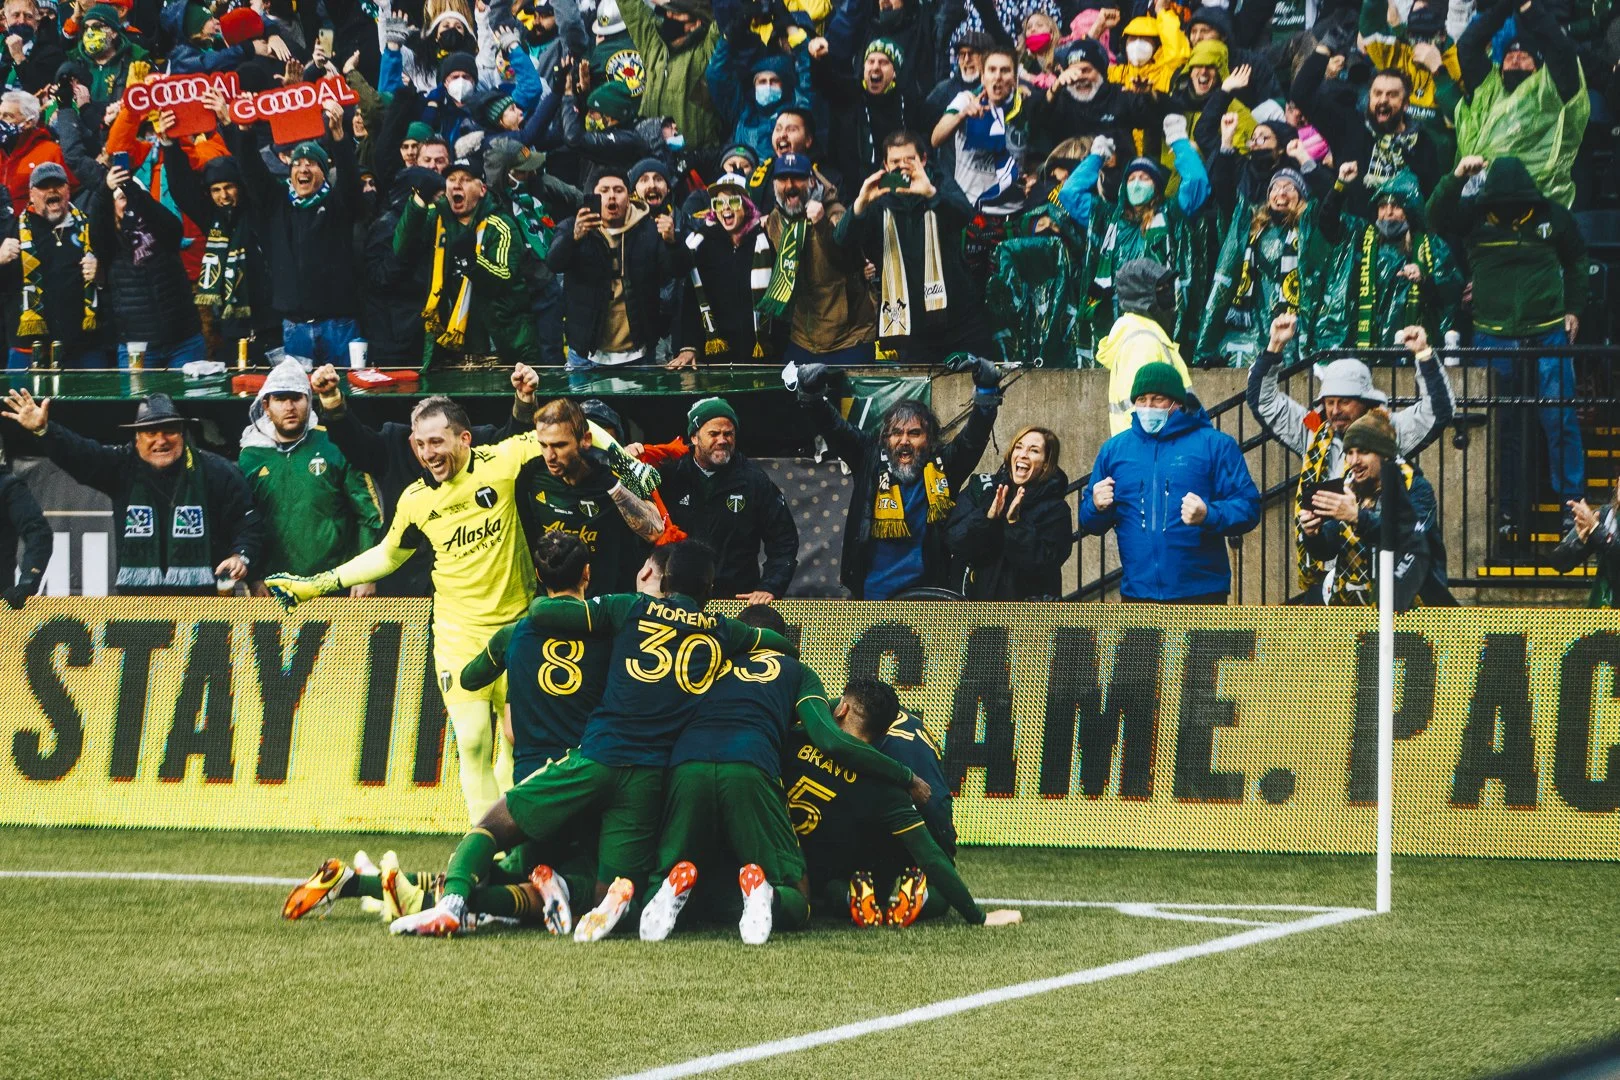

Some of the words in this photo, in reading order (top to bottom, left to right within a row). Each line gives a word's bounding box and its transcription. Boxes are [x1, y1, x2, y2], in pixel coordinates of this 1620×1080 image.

[174, 527, 203, 535] MLS
[443, 517, 502, 552] Alaska
[542, 520, 598, 544] Alka
[537, 637, 585, 697] 8
[625, 618, 722, 696] 30
[715, 648, 786, 684] 3
[12, 615, 331, 785] STAY
[1347, 629, 1620, 813] PAC
[785, 774, 838, 836] 5
